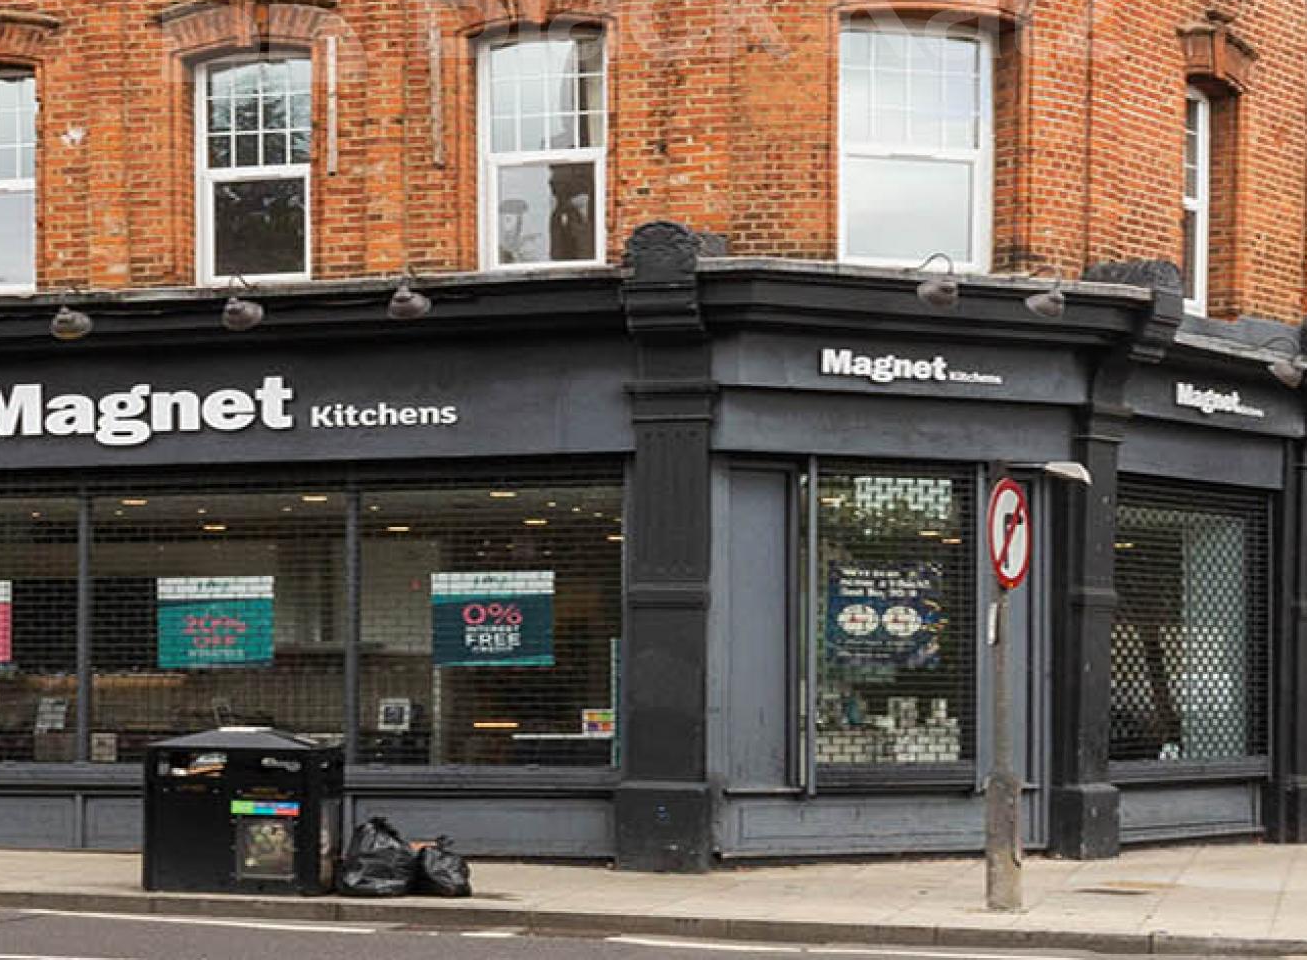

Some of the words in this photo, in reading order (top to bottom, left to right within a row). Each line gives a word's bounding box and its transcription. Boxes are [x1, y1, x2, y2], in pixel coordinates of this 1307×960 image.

[821, 348, 947, 383] Magnet
[1176, 381, 1240, 414] Magnet
[310, 402, 458, 429] Kitchens
[461, 602, 524, 626] 0%
[464, 632, 522, 648] FREE
